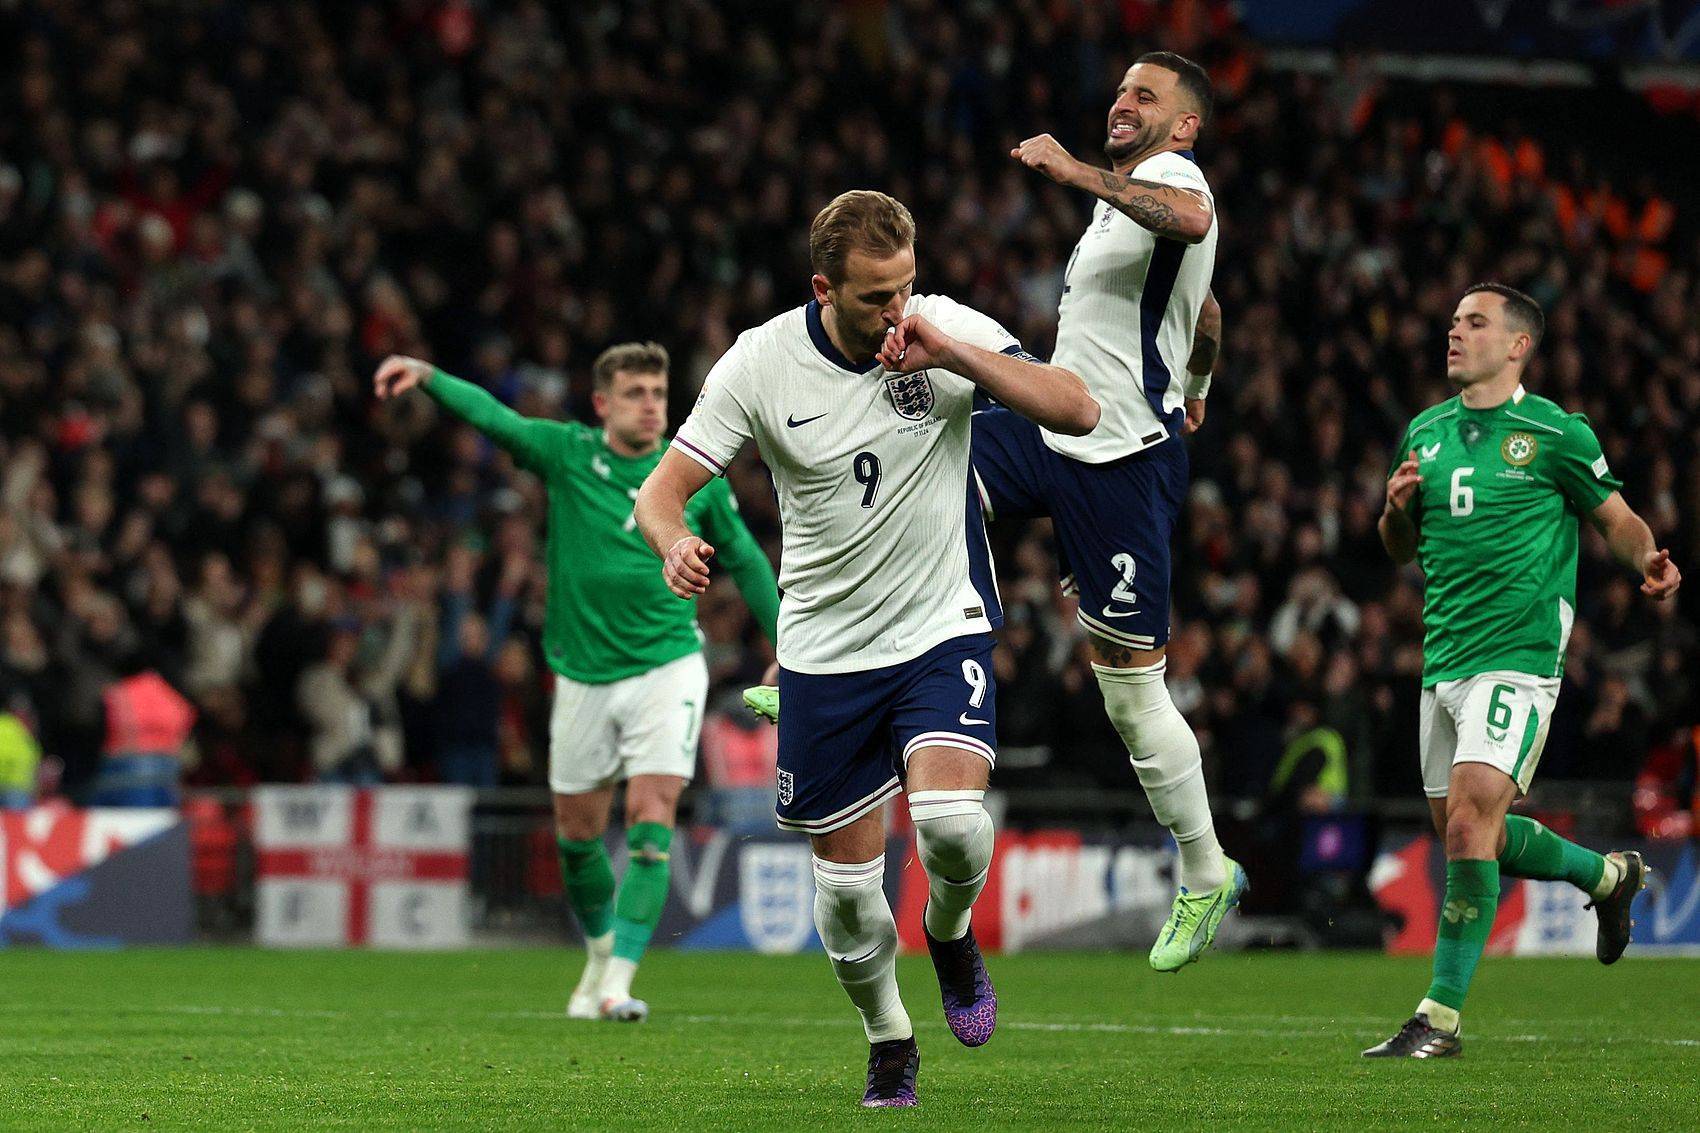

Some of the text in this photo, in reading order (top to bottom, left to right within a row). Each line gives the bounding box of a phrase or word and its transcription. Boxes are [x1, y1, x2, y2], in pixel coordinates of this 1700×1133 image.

[897, 424, 918, 435] REPUBLIC
[853, 451, 882, 509] 9
[1449, 466, 1475, 517] 6
[1111, 552, 1137, 604] 2
[961, 658, 987, 709] 9
[1487, 683, 1516, 730] 6
[682, 699, 695, 740] 7
